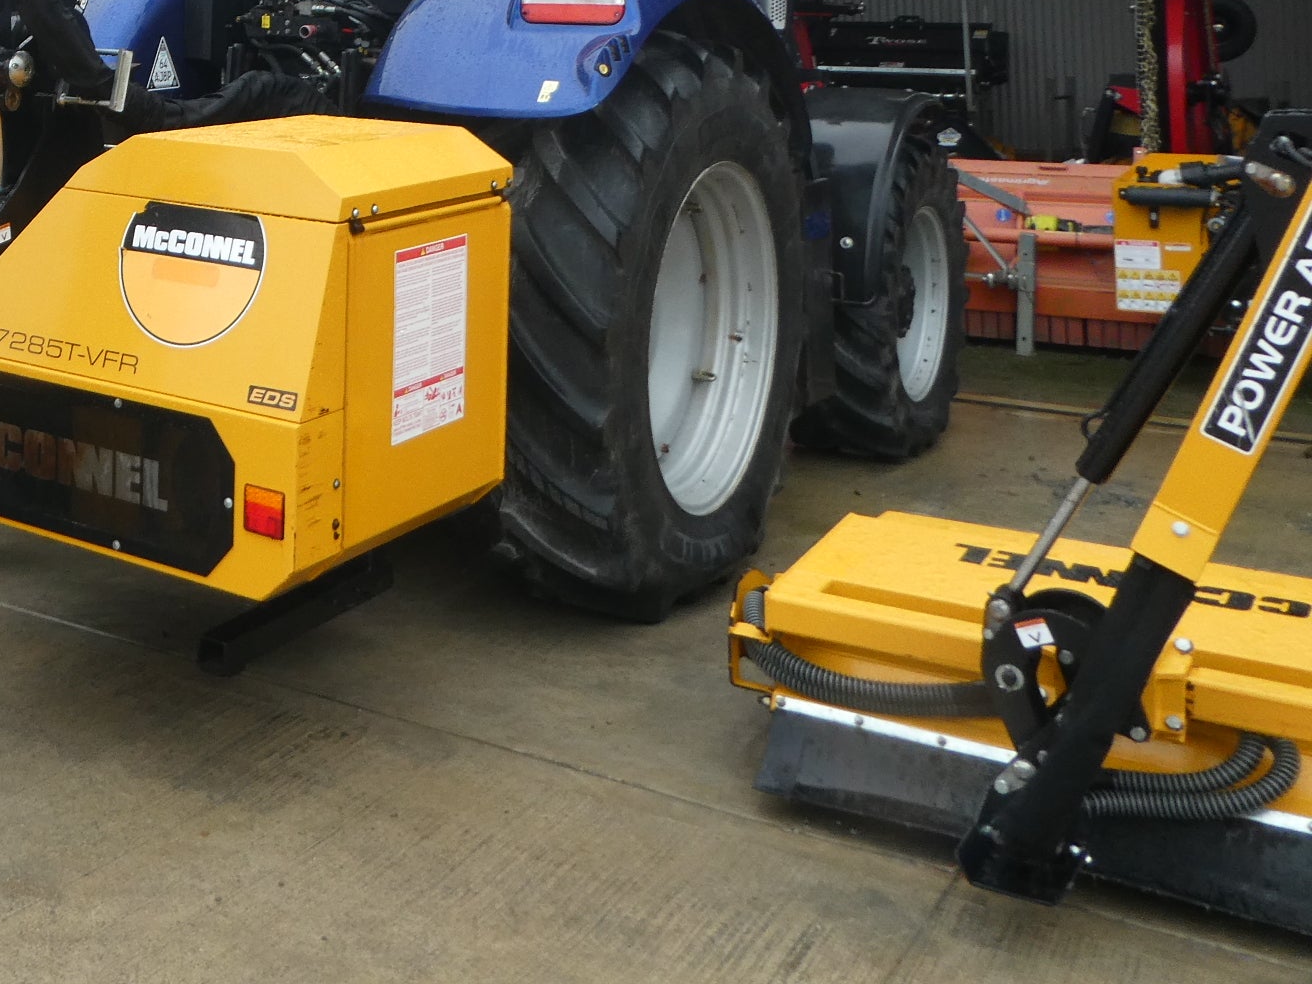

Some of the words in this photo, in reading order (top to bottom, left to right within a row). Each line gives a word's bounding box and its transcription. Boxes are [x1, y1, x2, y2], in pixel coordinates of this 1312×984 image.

[132, 224, 256, 265] McCONNEL
[1216, 290, 1312, 438] POWER
[248, 387, 296, 409] EDS
